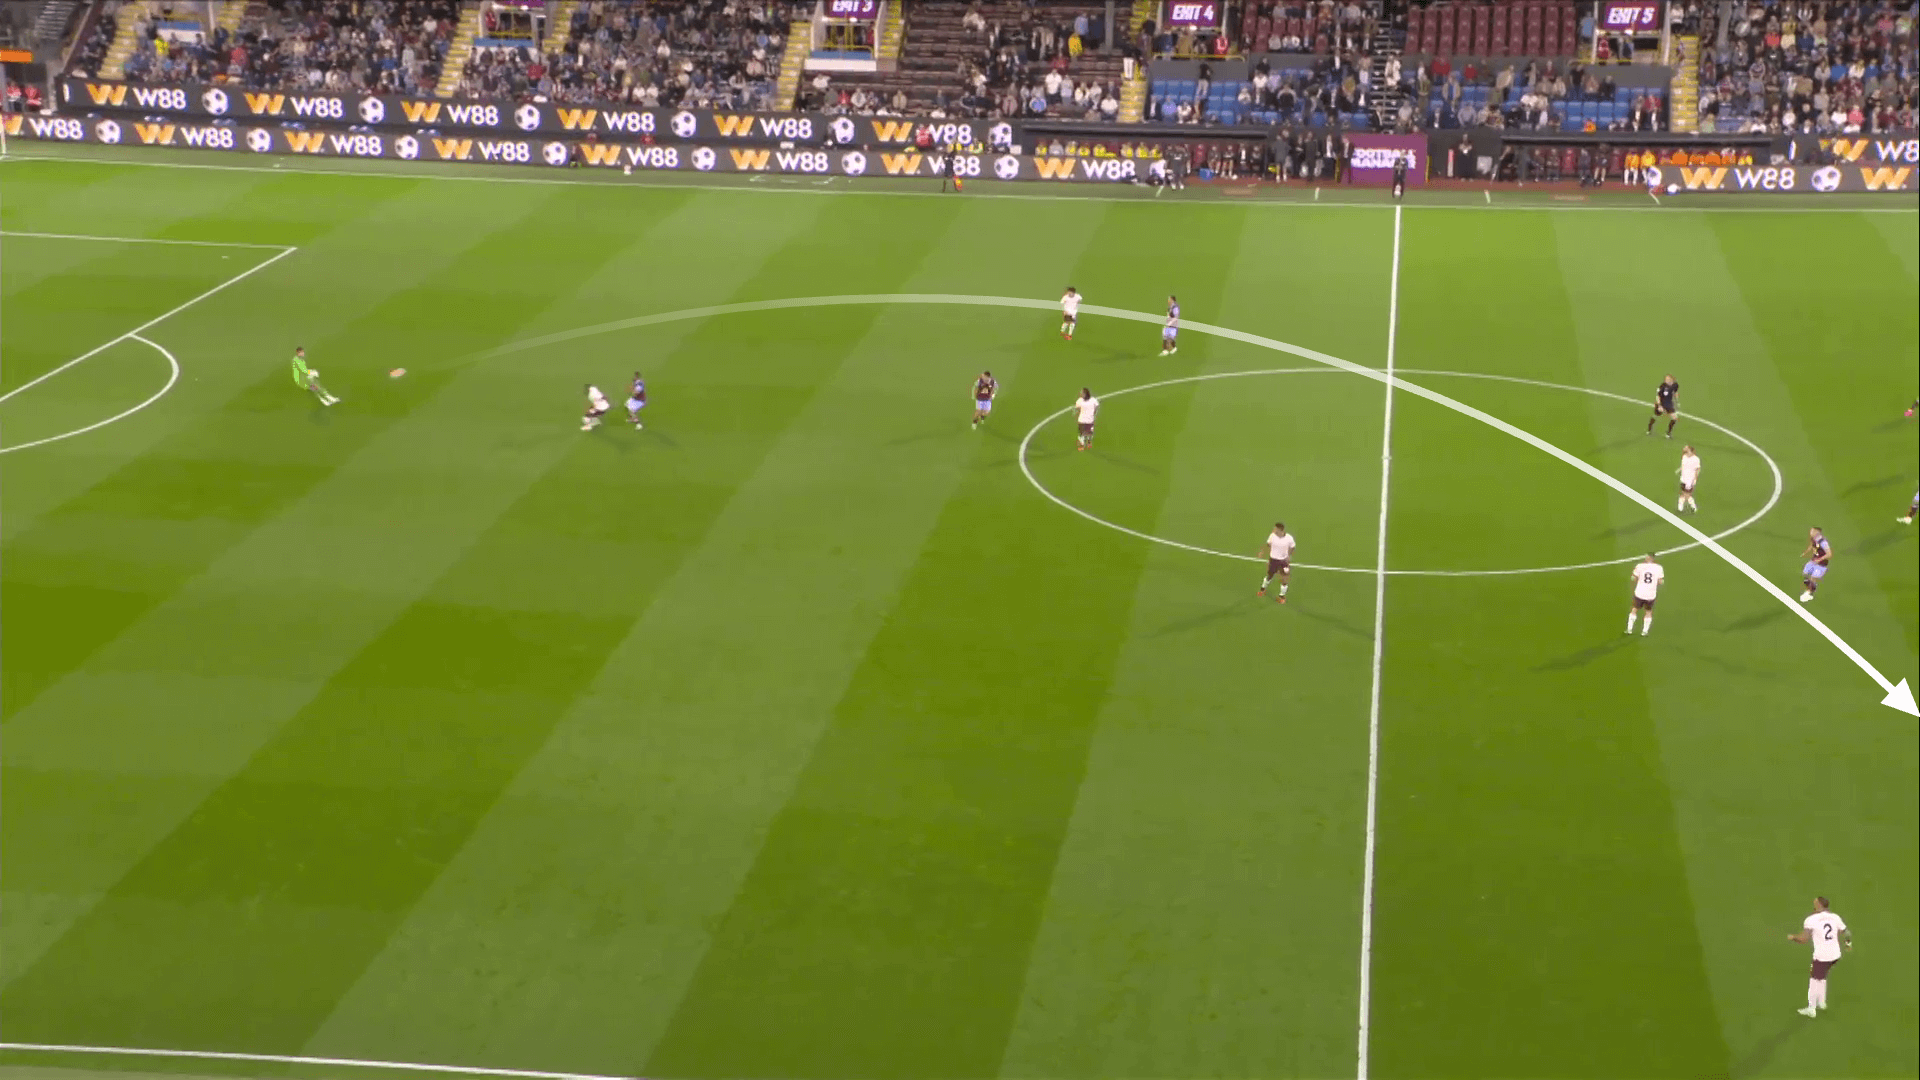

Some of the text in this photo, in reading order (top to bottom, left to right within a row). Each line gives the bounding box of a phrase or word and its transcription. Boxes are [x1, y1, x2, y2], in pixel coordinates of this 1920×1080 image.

[1172, 5, 1214, 21] EXIT 4
[1607, 7, 1655, 24] EXIT 5
[132, 86, 187, 110] W88
[290, 96, 344, 118] W88
[446, 104, 500, 126] W88
[602, 111, 655, 132] W88
[28, 117, 83, 140] W88
[181, 126, 234, 148] W88
[759, 117, 813, 139] W88
[330, 134, 383, 156] W88
[477, 141, 530, 162] W88
[626, 147, 679, 168] W88
[776, 152, 829, 172] W88
[1081, 159, 1136, 180] W88
[1734, 167, 1796, 190] W88
[1644, 571, 1652, 584] 8
[1823, 923, 1832, 940] 2
